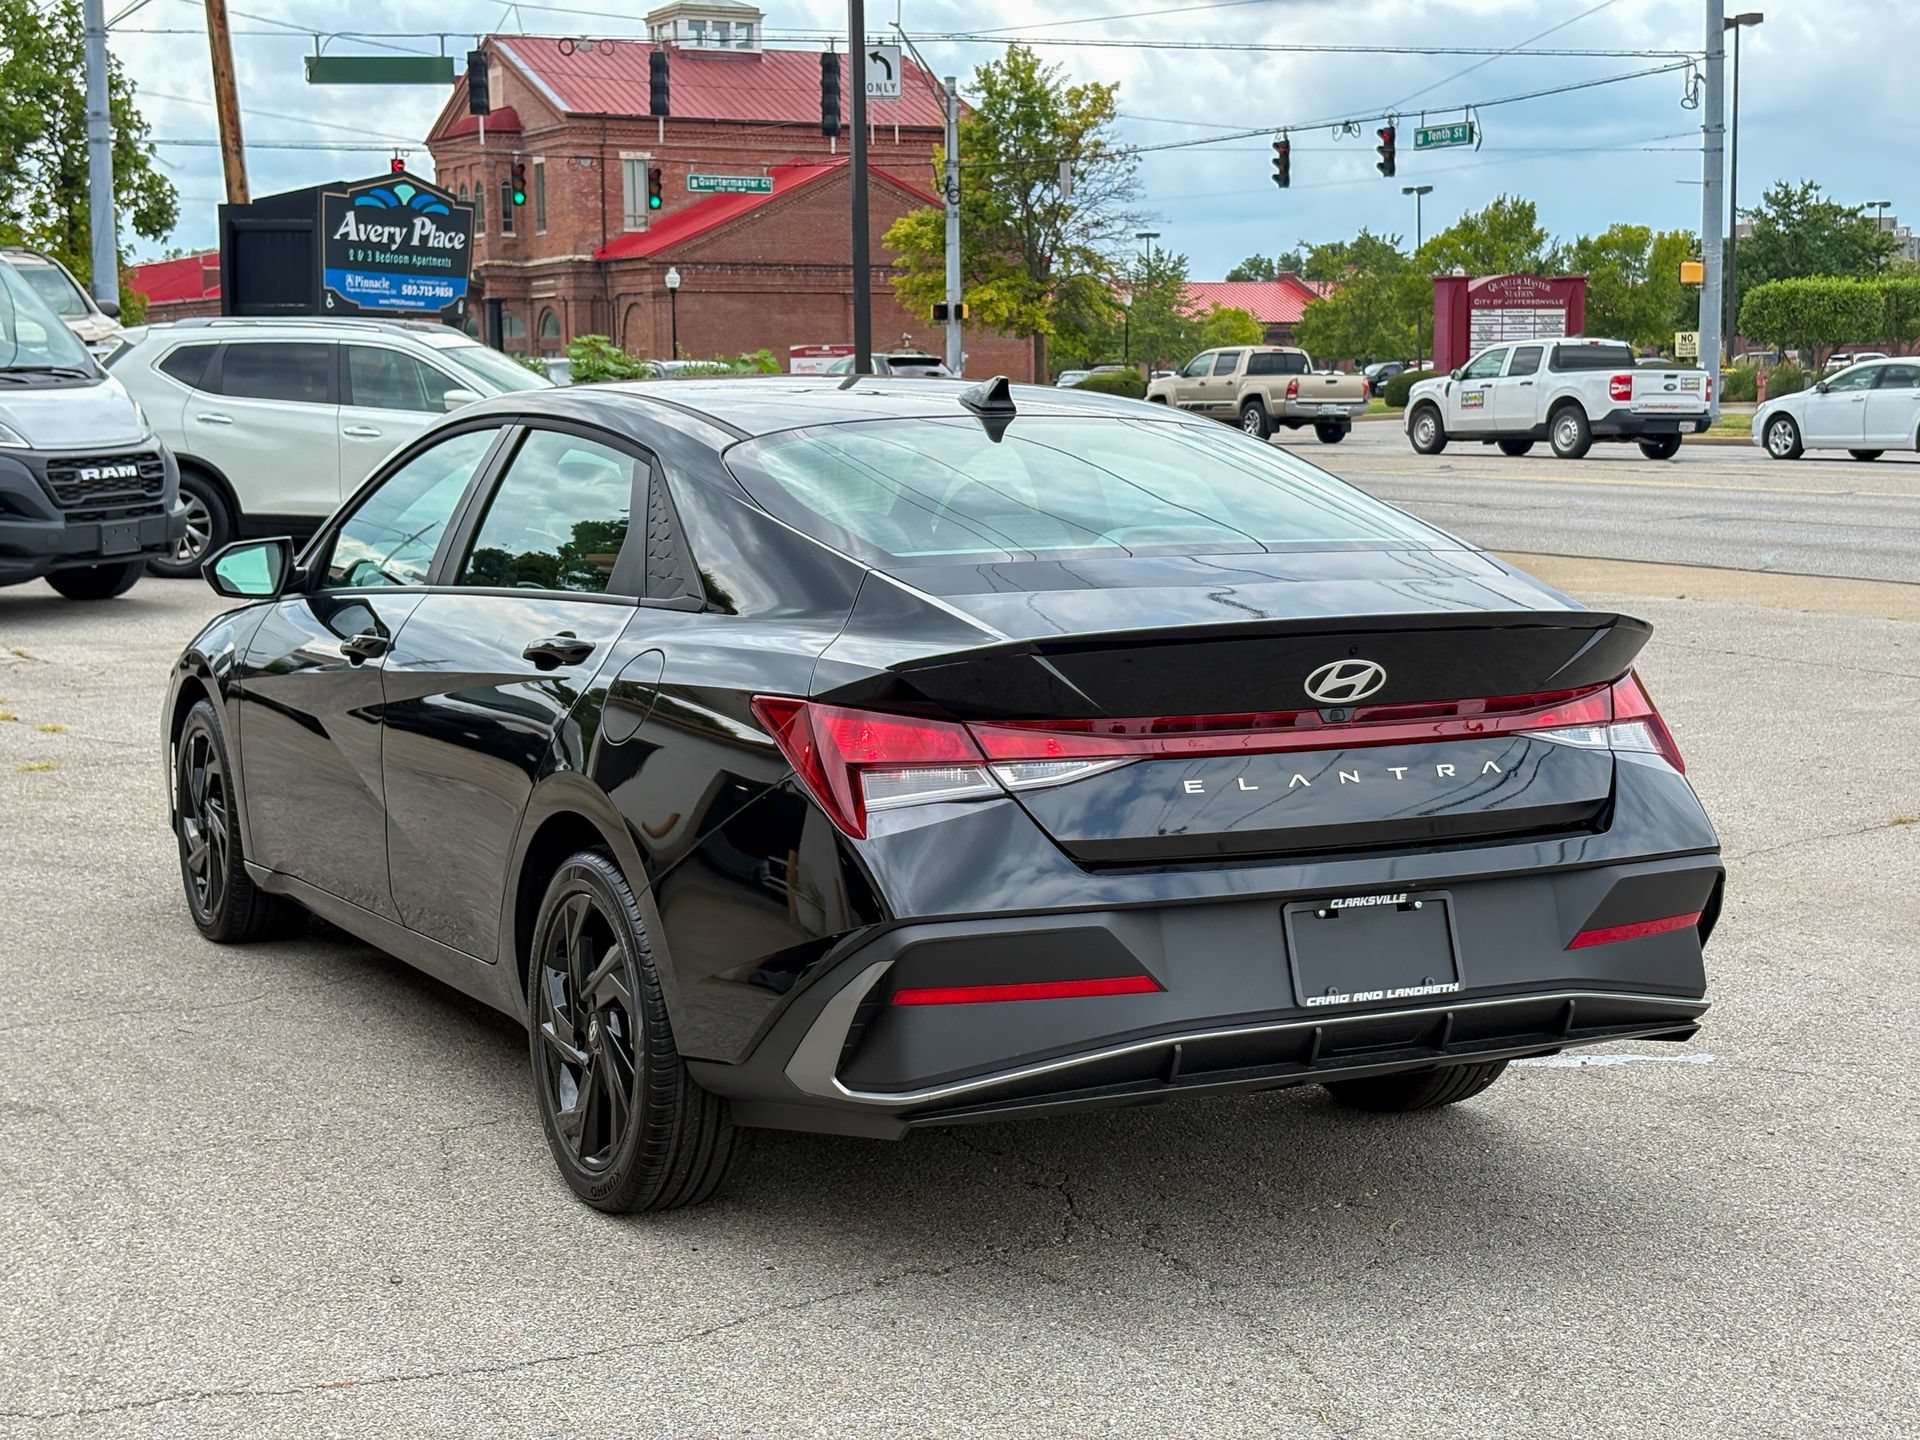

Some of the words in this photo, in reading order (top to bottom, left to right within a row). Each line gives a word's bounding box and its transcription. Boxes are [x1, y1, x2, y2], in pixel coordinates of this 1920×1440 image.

[867, 82, 897, 93] ONLY
[1427, 128, 1450, 141] Tenth
[1453, 127, 1463, 138] St
[698, 177, 759, 188] Quartermaster
[761, 179, 770, 188] Ct
[333, 210, 408, 252] Avery
[409, 216, 466, 250] Place
[348, 248, 355, 261] 2
[357, 249, 365, 262] &
[367, 250, 373, 262] 3
[375, 251, 410, 264] Bedroom
[411, 254, 452, 268] Apartments
[354, 275, 390, 289] Pinnacle
[1487, 278, 1521, 293] QUARTER
[1523, 277, 1551, 293] MASTER
[1473, 298, 1491, 306] CITY
[1493, 298, 1501, 306] OF
[1504, 298, 1564, 306] JEFFERSONVILLE
[1504, 290, 1535, 298] STATION
[1681, 333, 1694, 343] NO
[80, 465, 137, 481] RAM
[1183, 760, 1502, 794] ELANTRA
[1330, 893, 1407, 909] CLARKSVILLE
[1306, 993, 1350, 1007] CRAIG
[1353, 990, 1384, 1002] AND
[1386, 982, 1459, 999] LANDRETH
[590, 1168, 622, 1197] KUMHO
